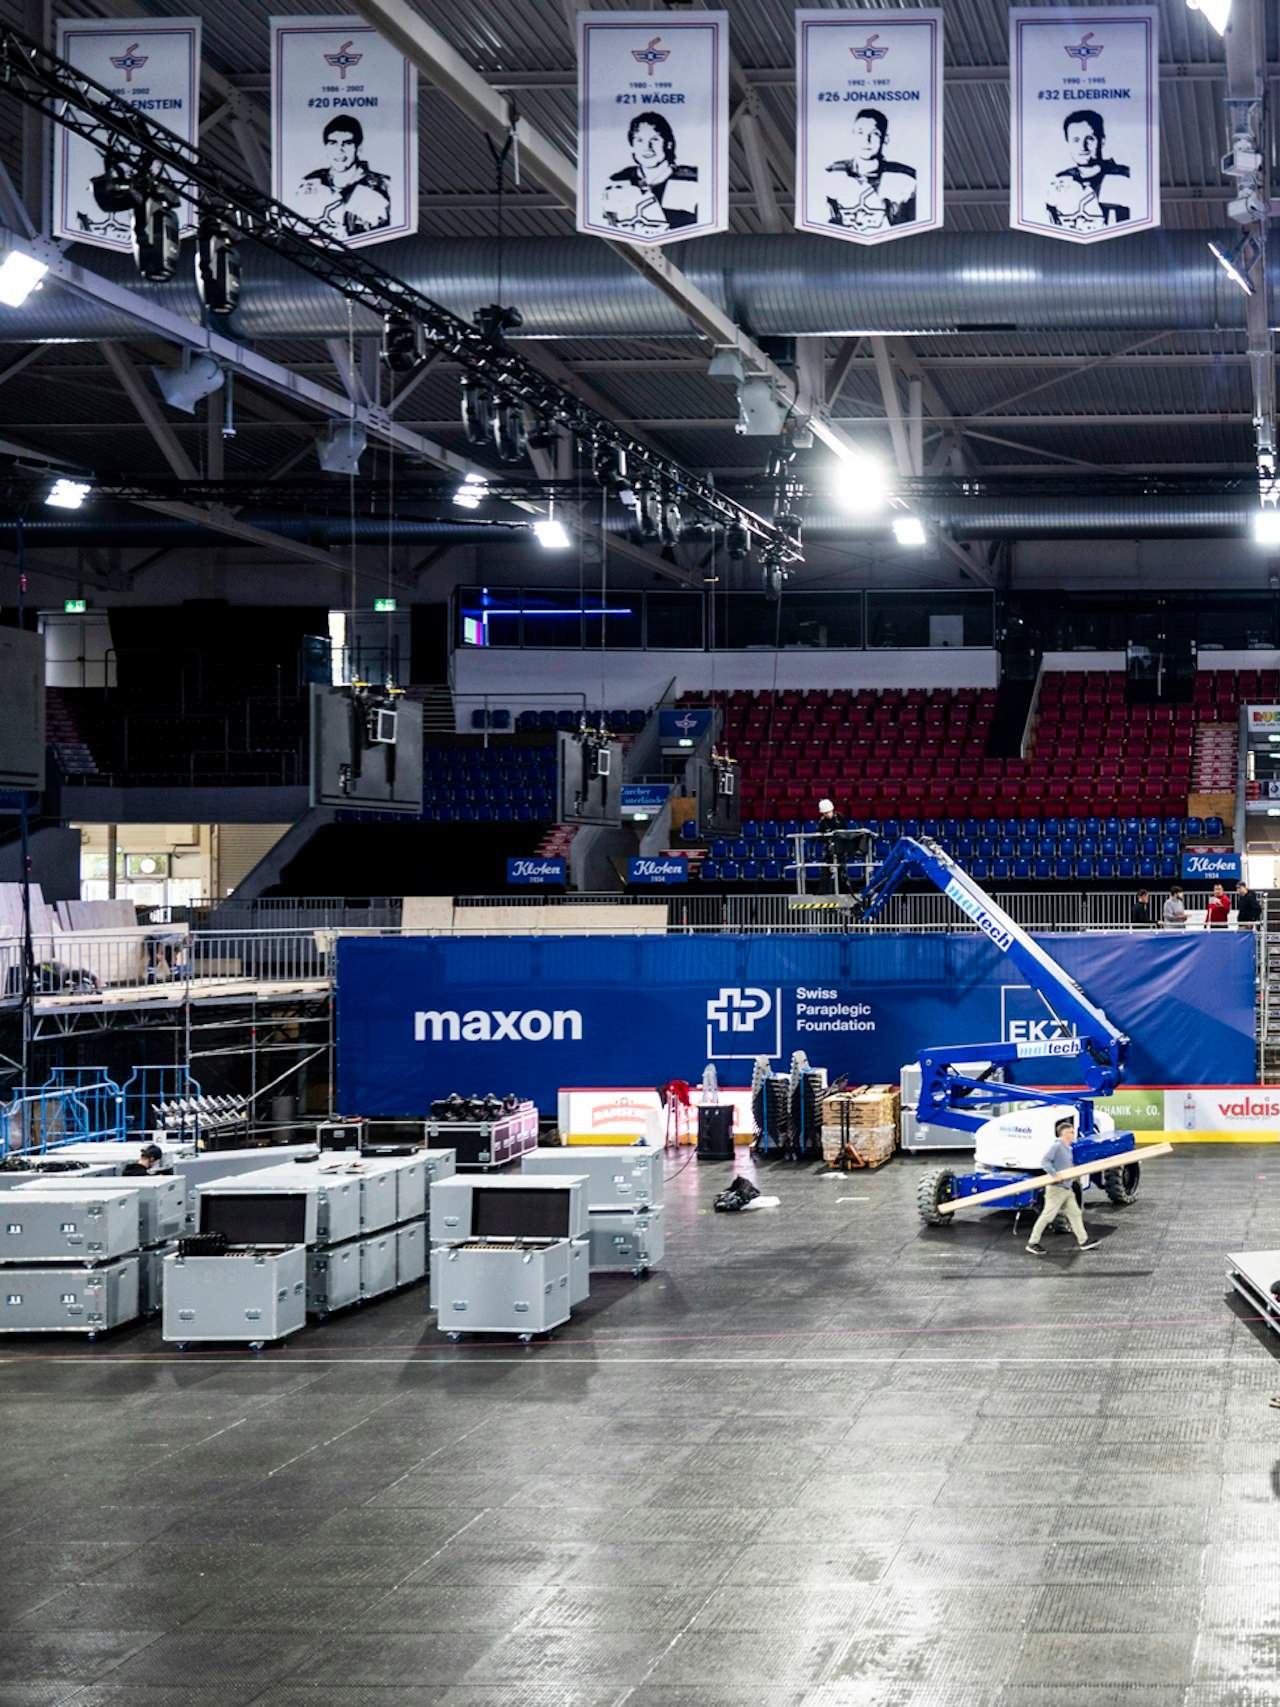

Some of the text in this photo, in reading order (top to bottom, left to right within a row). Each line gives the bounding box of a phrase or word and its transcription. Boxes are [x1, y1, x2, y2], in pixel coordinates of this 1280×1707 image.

[616, 92, 685, 104] #21 WÄGER
[818, 91, 920, 102] #26 JOHANSSON
[1038, 88, 1131, 100] #32 ELDEBRINK
[307, 97, 378, 108] #20 PAVONI
[512, 861, 561, 875] Kloten
[633, 861, 682, 875] Kloten
[1187, 857, 1236, 872] Kloten
[796, 987, 838, 1000] Swiss
[796, 1003, 871, 1018] Paraplegic
[414, 1009, 583, 1041] maxon
[796, 1019, 875, 1032] Foundation
[1009, 1020, 1069, 1042] EKZ
[1096, 1104, 1161, 1117] CHANIK + CO.
[1218, 1096, 1280, 1117] valais
